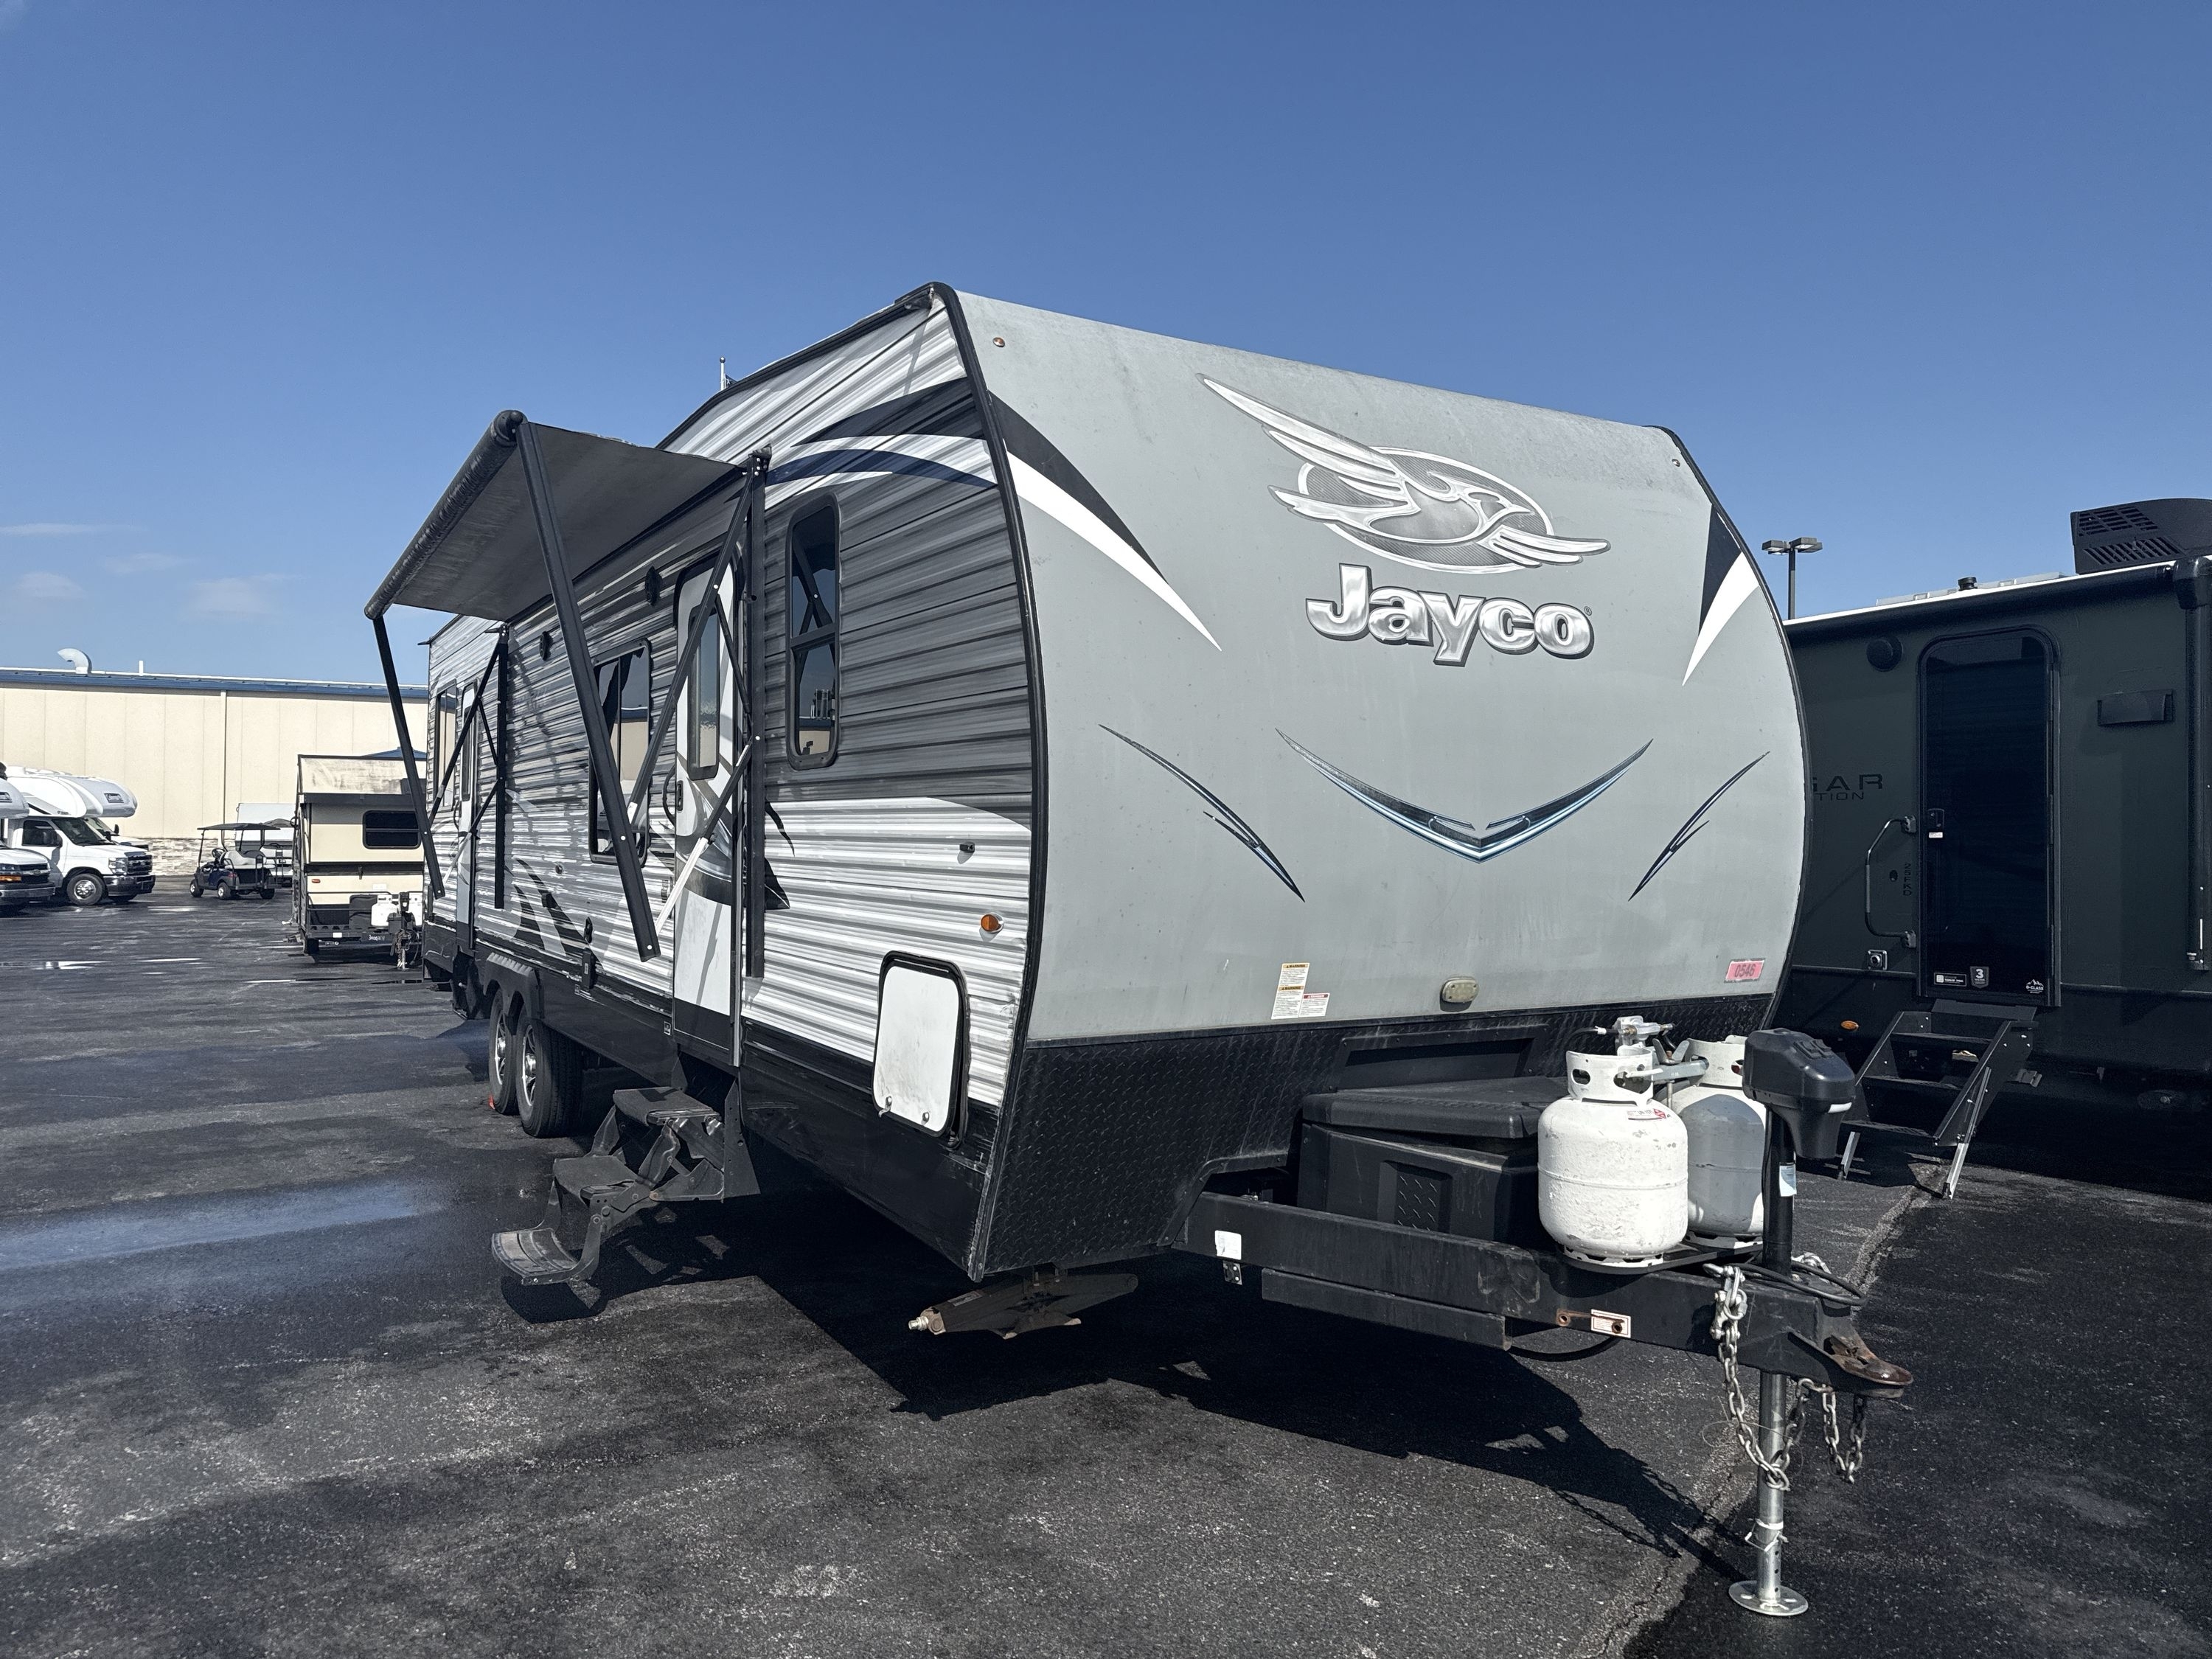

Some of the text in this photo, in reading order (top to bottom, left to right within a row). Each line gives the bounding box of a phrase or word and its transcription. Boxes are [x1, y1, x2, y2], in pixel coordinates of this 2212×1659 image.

[1306, 563, 1594, 667] Jayco
[1734, 964, 1756, 978] 0546
[1975, 968, 1984, 979] 3
